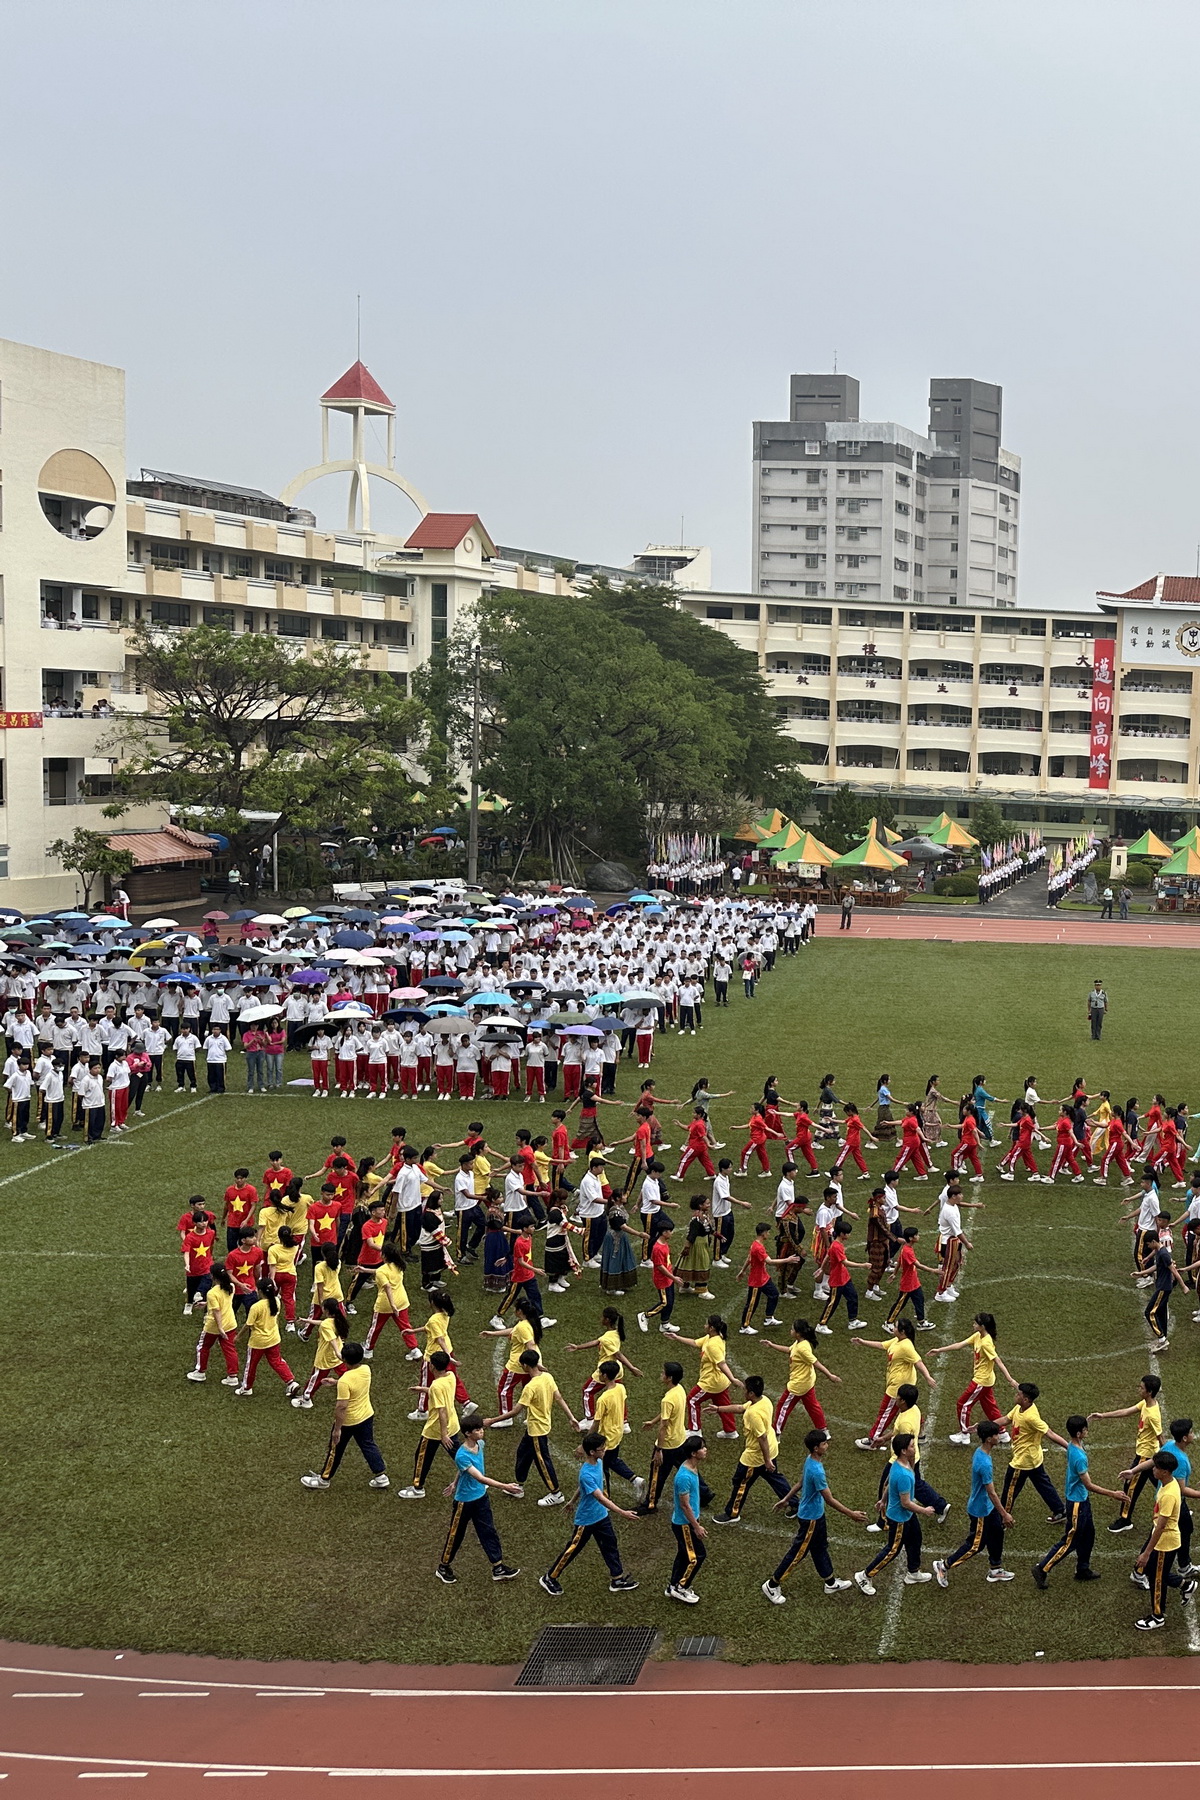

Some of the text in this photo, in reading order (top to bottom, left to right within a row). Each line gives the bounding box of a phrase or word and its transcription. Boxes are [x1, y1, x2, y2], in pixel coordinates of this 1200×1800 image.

[1130, 626, 1139, 648] 領導
[1146, 626, 1155, 649] 自動
[1161, 628, 1171, 649] 坦誠
[1090, 657, 1113, 779] 邁向高峰
